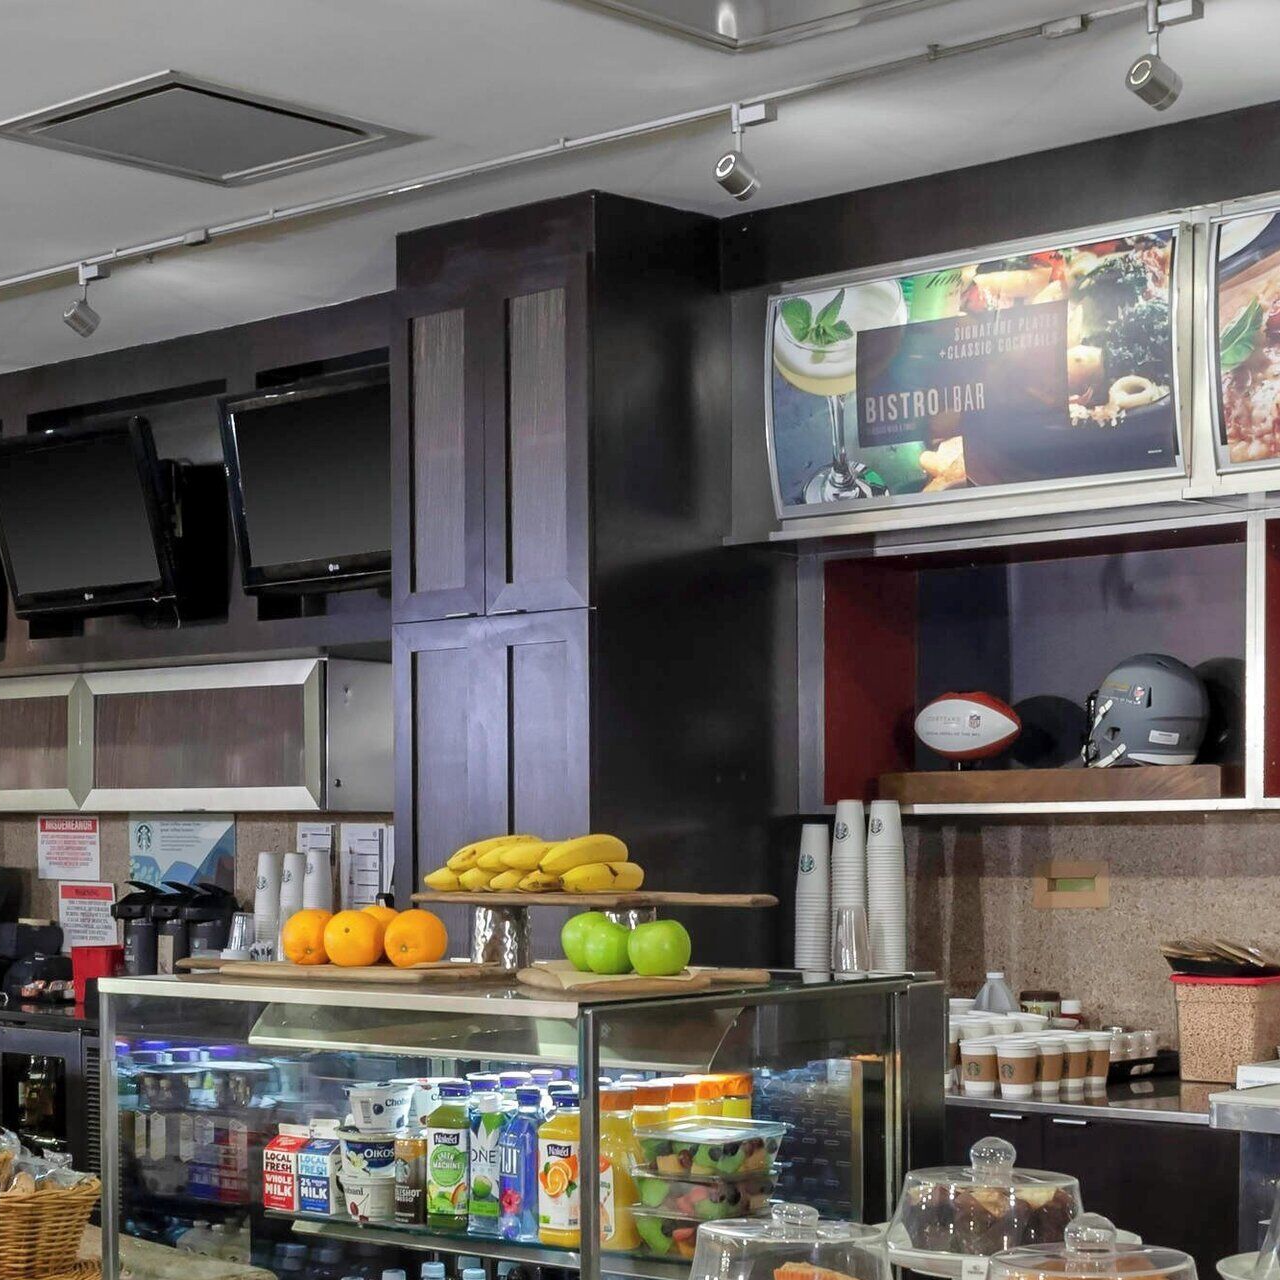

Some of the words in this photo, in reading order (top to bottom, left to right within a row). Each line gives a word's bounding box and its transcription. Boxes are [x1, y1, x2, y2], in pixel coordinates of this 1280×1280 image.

[954, 318, 1012, 342] SIGNATURE
[865, 388, 939, 424] BISTRO
[953, 383, 985, 414] BAR
[265, 1151, 292, 1162] LOCAL
[364, 1148, 395, 1158] OIKOS
[300, 1154, 328, 1164] LOCAL
[265, 1161, 292, 1173] FRESH
[300, 1164, 328, 1175] FRESH
[265, 1174, 293, 1184] WHOLE
[265, 1183, 293, 1197] MILK
[300, 1186, 328, 1200] MILK
